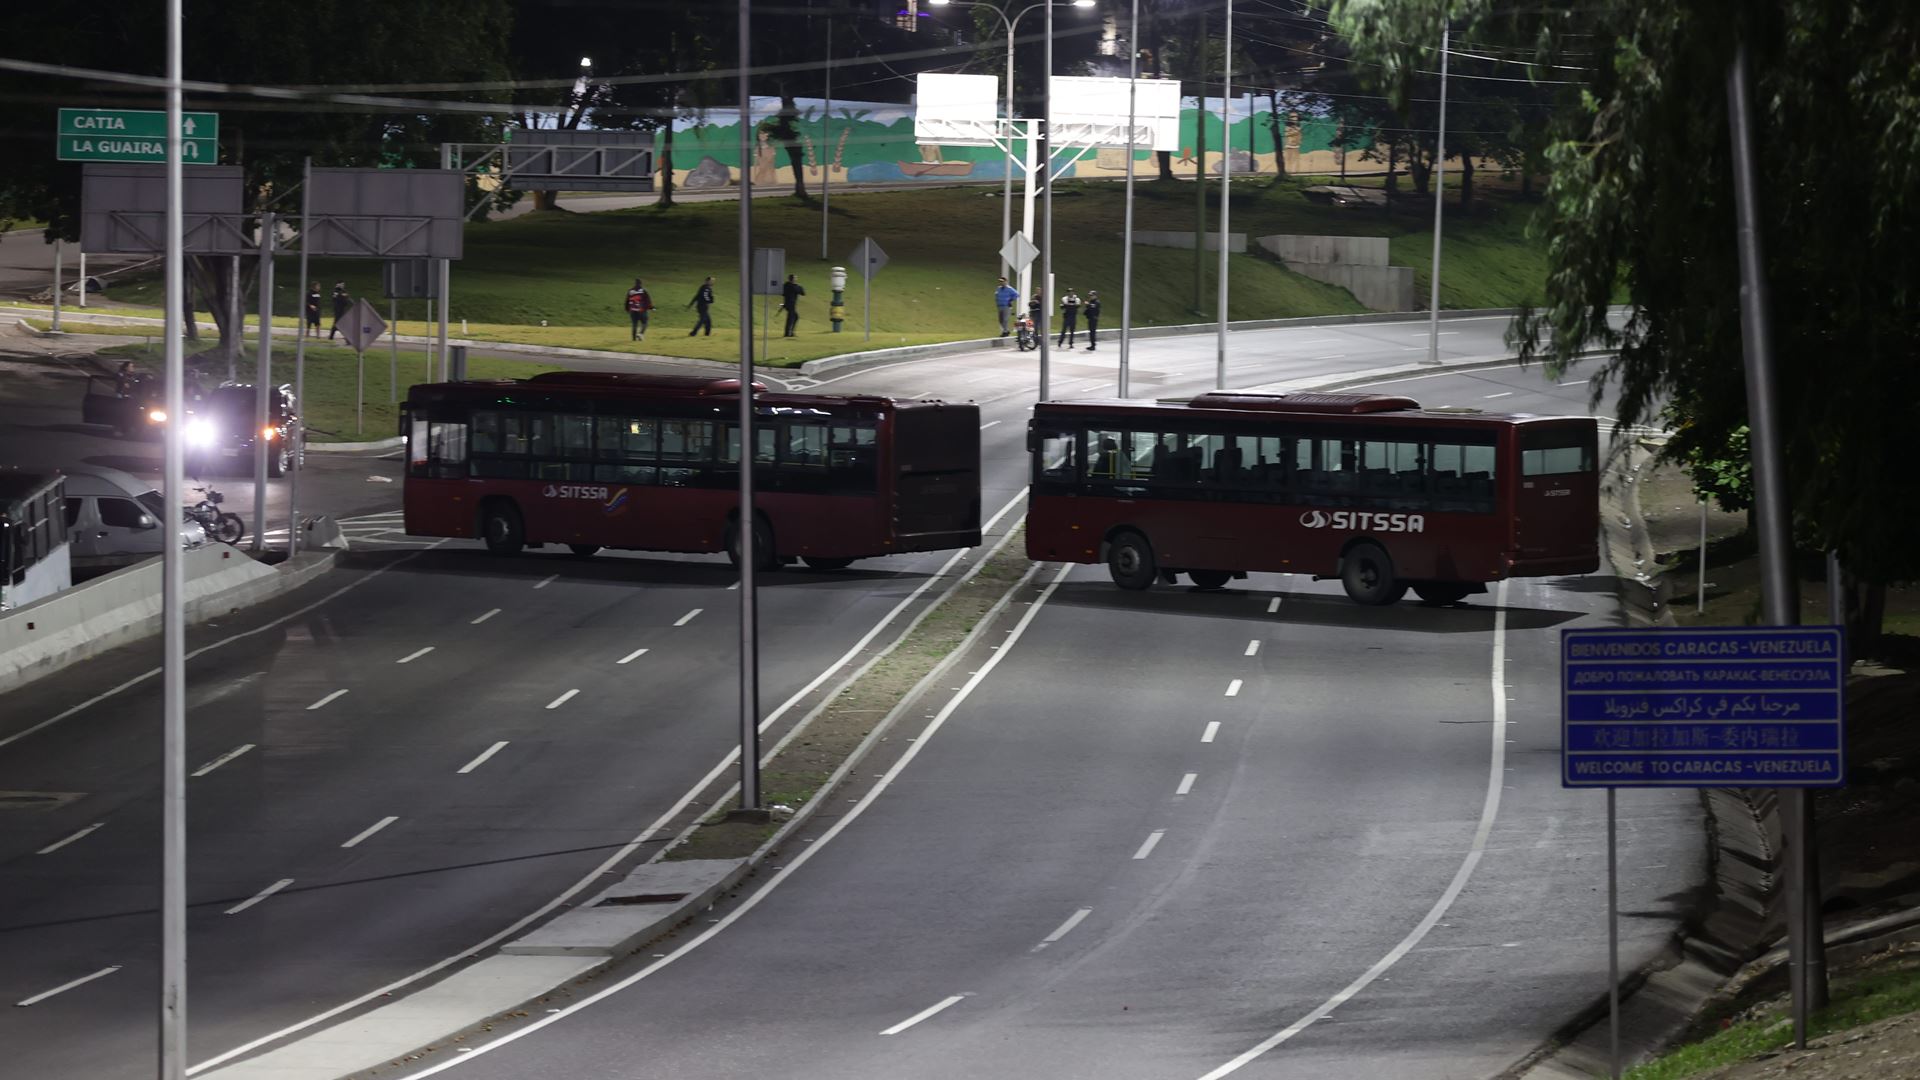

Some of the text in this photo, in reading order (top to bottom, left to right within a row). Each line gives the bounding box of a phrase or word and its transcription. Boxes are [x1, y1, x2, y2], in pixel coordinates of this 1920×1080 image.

[73, 116, 126, 129] CATIA
[72, 140, 164, 154] LA GUAIRA
[559, 485, 608, 499] SITSSA
[1332, 511, 1424, 533] SITSSA
[1571, 642, 1661, 657] BIENVENIDOS
[1574, 671, 1614, 685] ДОБРО
[1617, 670, 1700, 682] ПОЖАЛОВАТЬ
[1652, 697, 1702, 718] كراكس
[1707, 696, 1728, 719] في
[1730, 695, 1756, 716] بكم
[1575, 760, 1644, 775] WELCOME
[1651, 760, 1670, 774] TO
